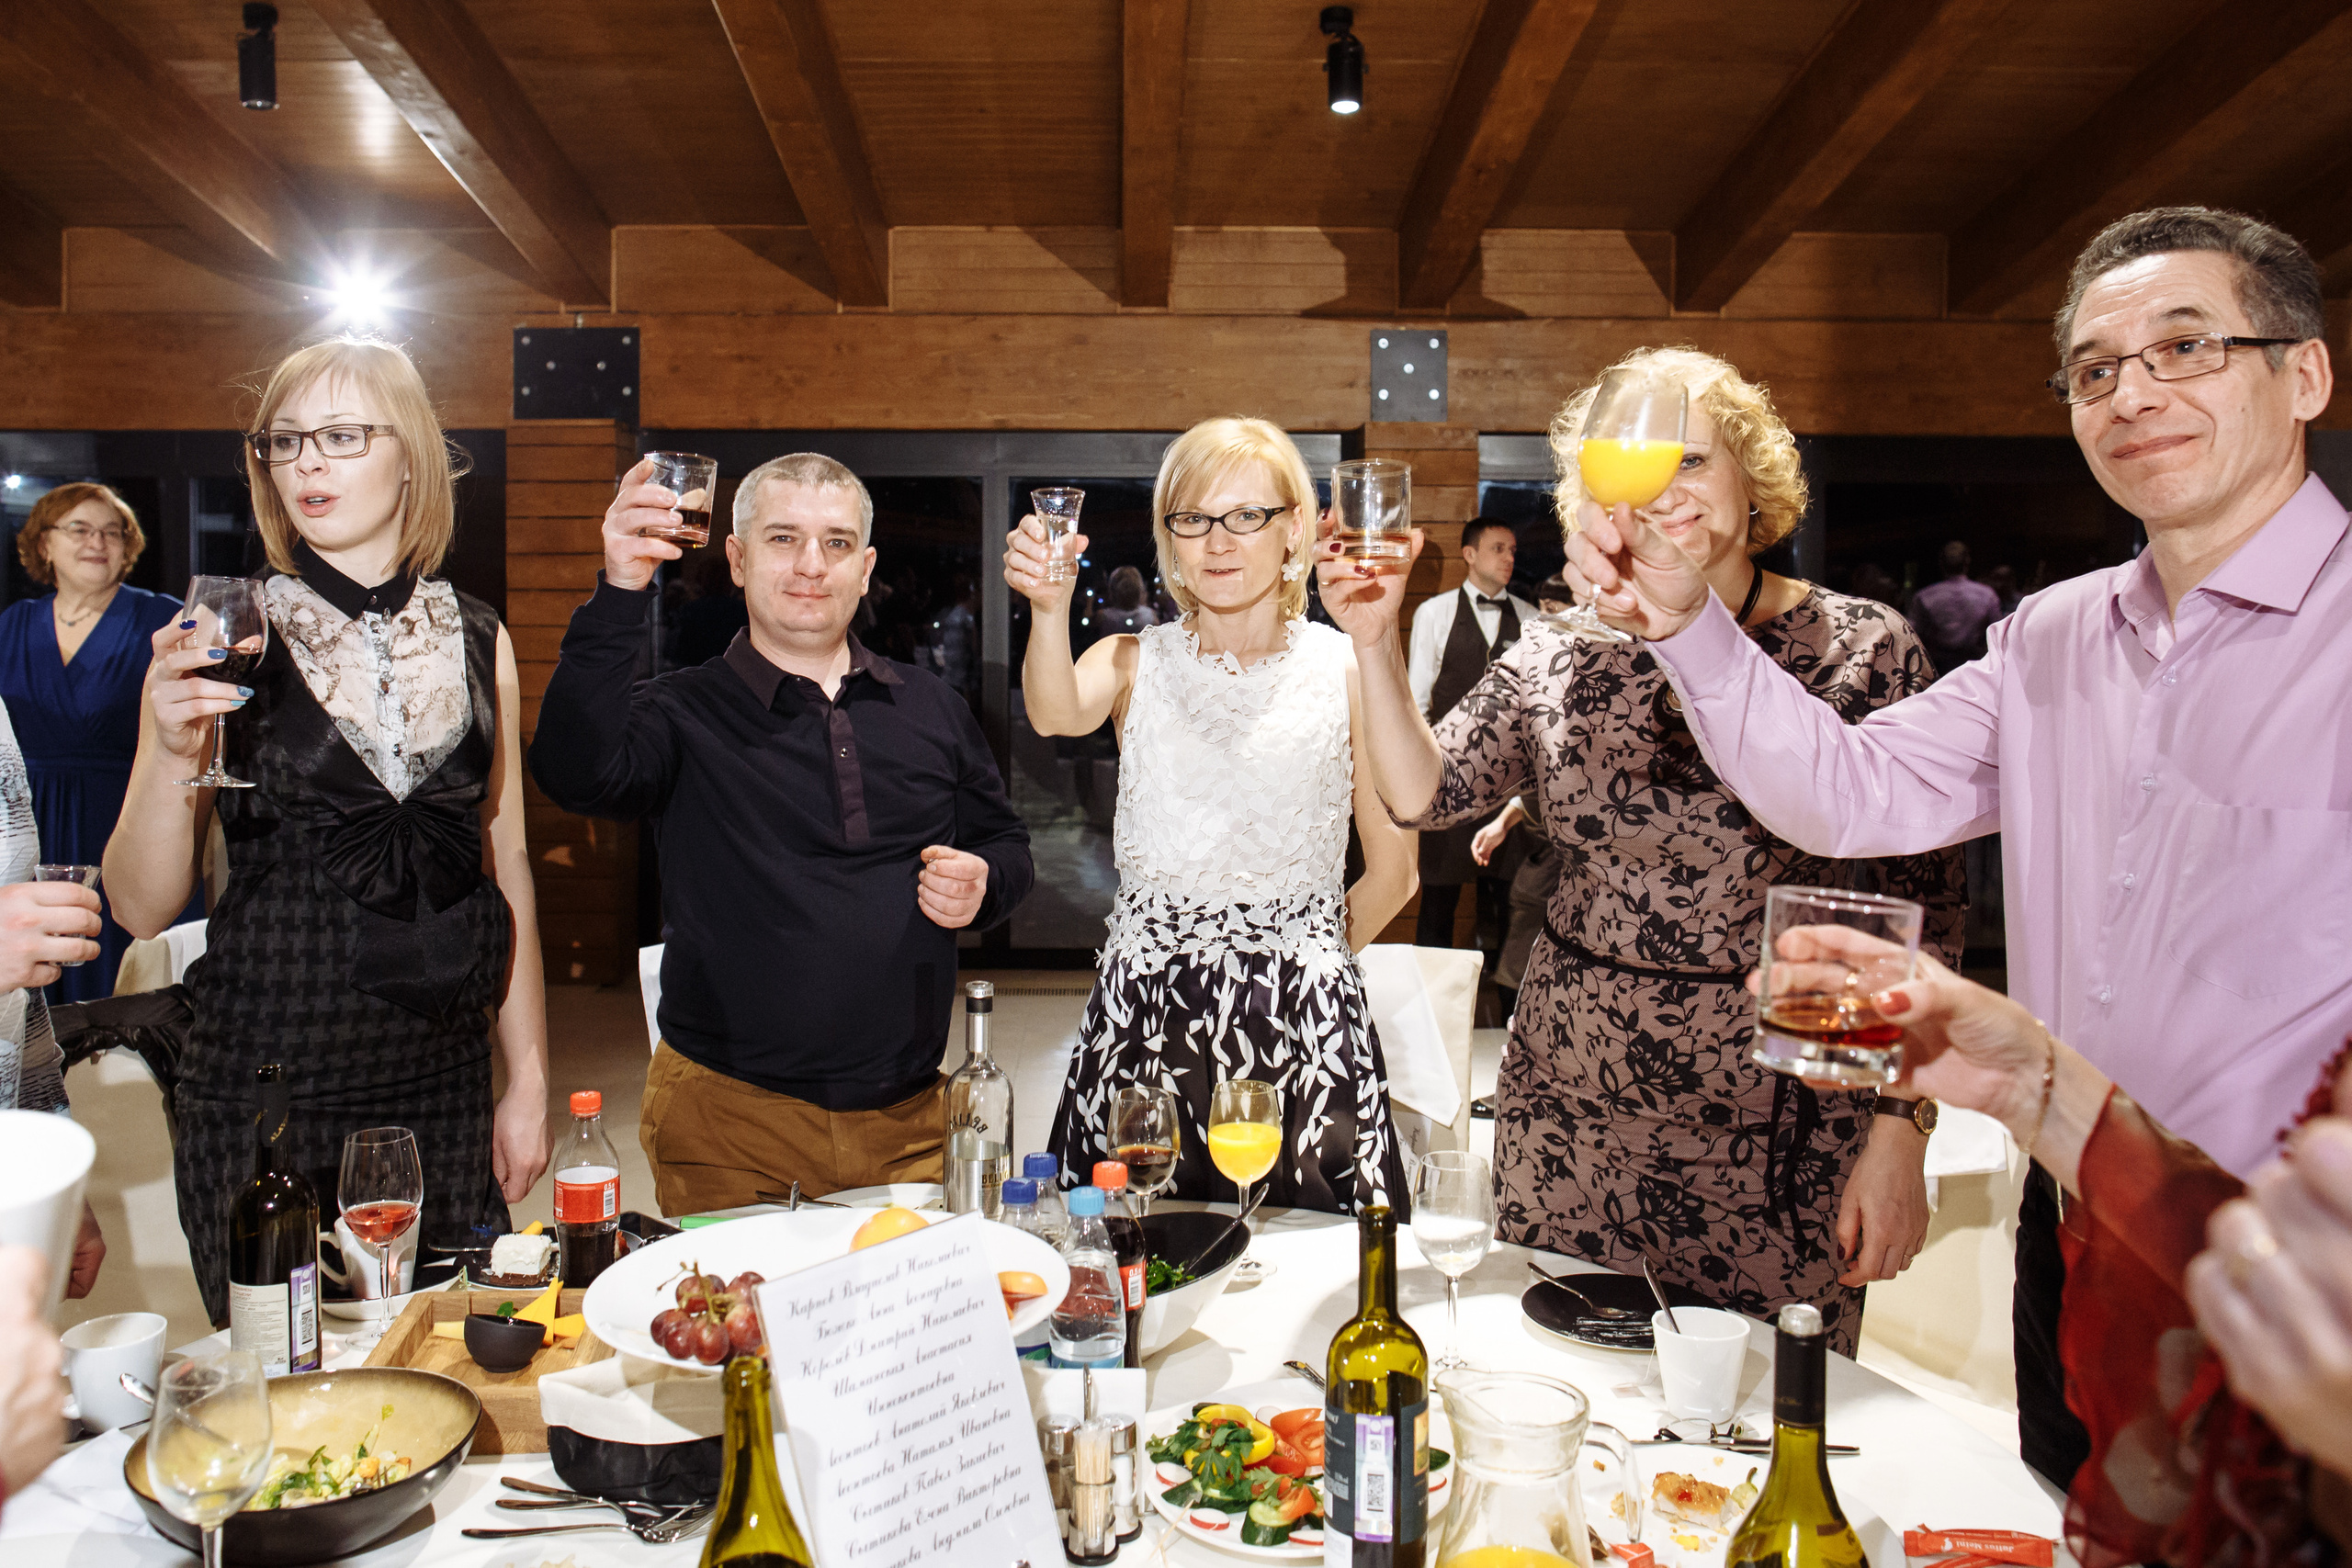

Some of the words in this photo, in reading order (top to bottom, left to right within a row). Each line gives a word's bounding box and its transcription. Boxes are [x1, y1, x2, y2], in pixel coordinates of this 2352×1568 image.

[906, 1244, 971, 1273] Николаевич
[922, 1298, 985, 1331] Николаевич
[912, 1333, 973, 1368] Анастасия
[890, 1402, 947, 1440] Анатолий
[950, 1380, 1007, 1415] Яковлевич
[900, 1435, 955, 1469] Наталья
[959, 1408, 1012, 1438] Ивановна
[914, 1470, 951, 1495] Павел
[954, 1464, 1022, 1507] Викторовна
